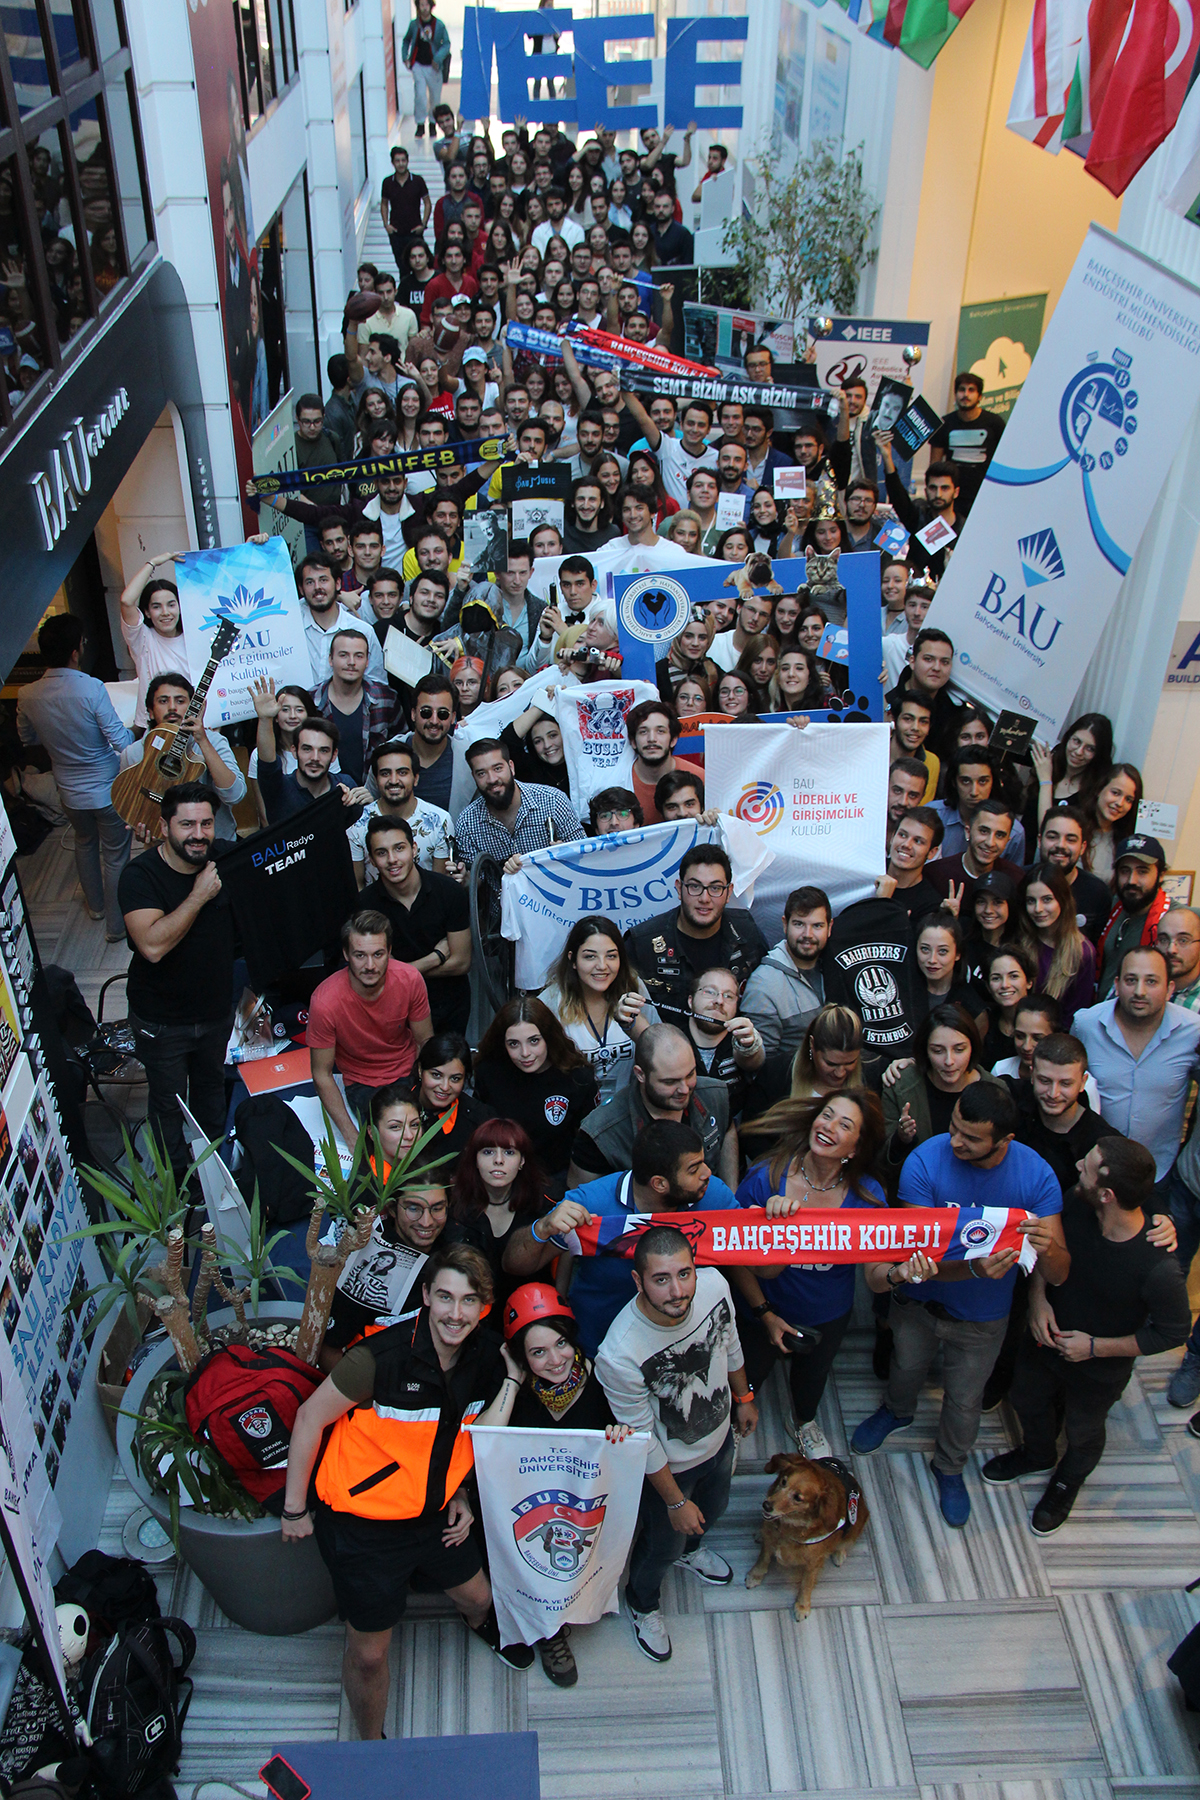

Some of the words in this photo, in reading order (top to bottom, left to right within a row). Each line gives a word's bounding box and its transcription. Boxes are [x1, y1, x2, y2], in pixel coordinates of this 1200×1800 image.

[460, 6, 749, 132] IEEE
[857, 326, 893, 341] IEEE
[653, 376, 687, 399] SEMT
[691, 377, 727, 402] BİZİM
[760, 387, 797, 408] BİZİM
[977, 570, 1064, 651] BAU
[974, 611, 1010, 641] Bahçeşehir
[1012, 637, 1046, 668] University
[239, 646, 294, 666] Eğitimciler
[793, 777, 815, 790] BAU
[793, 791, 841, 805] LİDERLİK
[844, 793, 858, 804] VE
[792, 806, 865, 823] GİRİŞİMCİLİK
[791, 823, 832, 837] KULÜBÜ
[251, 839, 287, 868] BAU
[286, 833, 315, 851] Radyo
[264, 848, 307, 876] TEAM
[518, 893, 541, 913] BAU
[840, 945, 901, 966] BAURIDERS
[862, 968, 889, 989] BAU
[712, 1221, 852, 1255] BAHÇEŞEHİR
[858, 1221, 941, 1251] KOLEJİ
[549, 1446, 572, 1454] T.C.
[518, 1464, 602, 1480] ÜNİVERSİTESİ
[520, 1456, 600, 1471] BAHÇEŞEHİR
[518, 1492, 604, 1514] BUSAR
[516, 1588, 549, 1605] ARAMA
